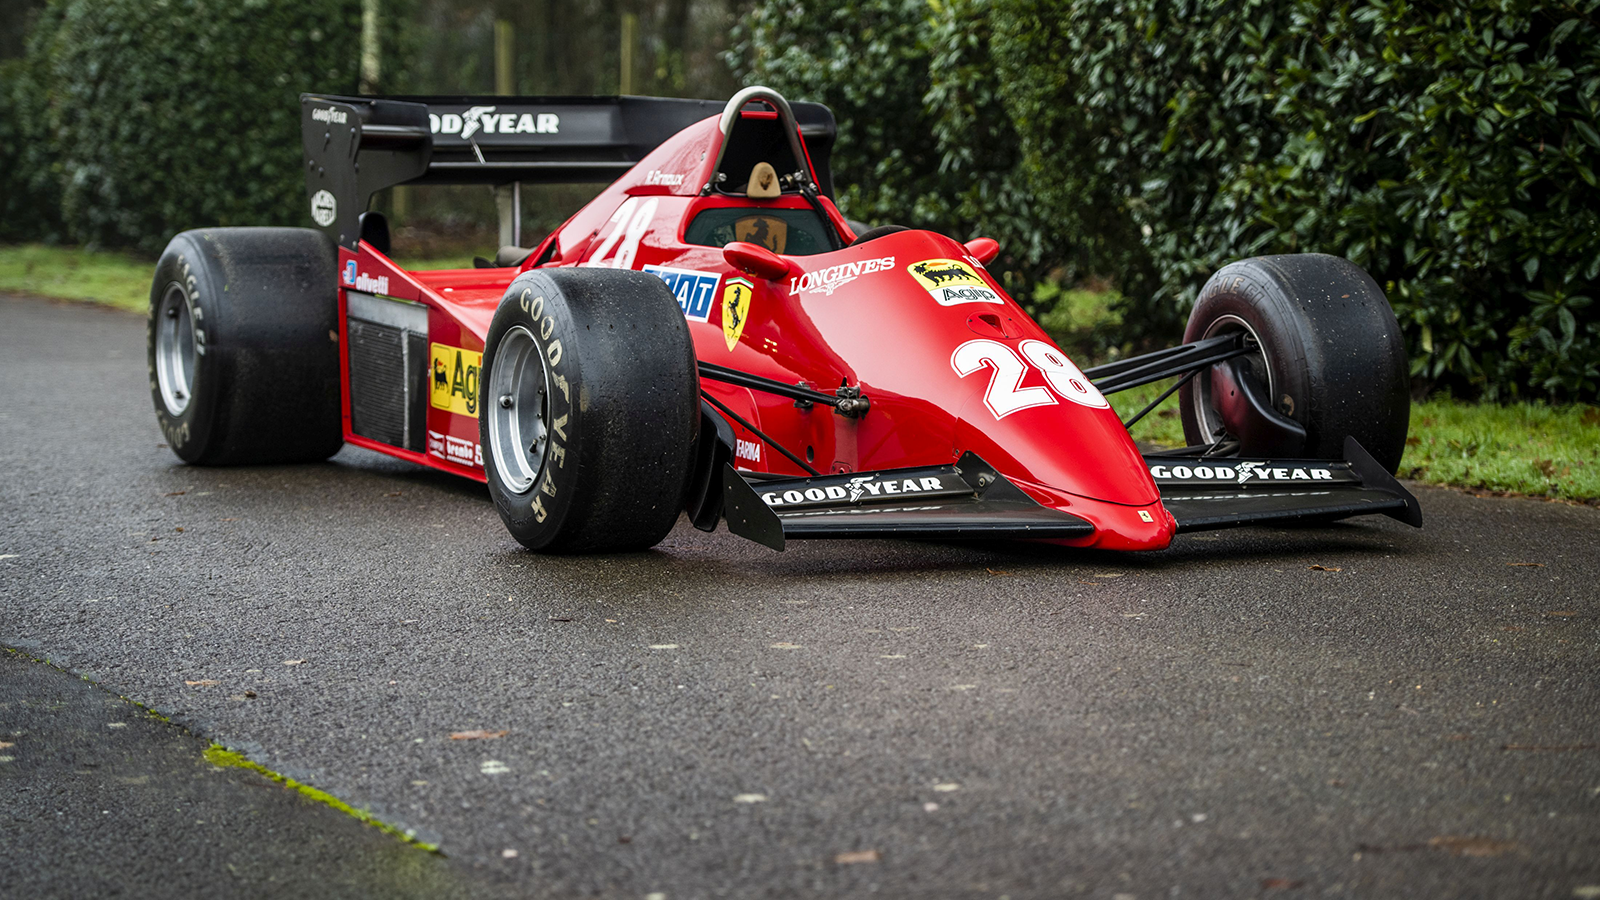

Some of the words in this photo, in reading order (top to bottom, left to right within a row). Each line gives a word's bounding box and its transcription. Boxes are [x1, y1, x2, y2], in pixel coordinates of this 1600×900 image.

[588, 196, 660, 269] 28
[665, 278, 713, 311] AT
[789, 256, 895, 296] LONGINES
[942, 286, 996, 301] Agip
[451, 350, 481, 414] Ag
[950, 338, 1112, 421] 28
[735, 438, 760, 463] FARINA
